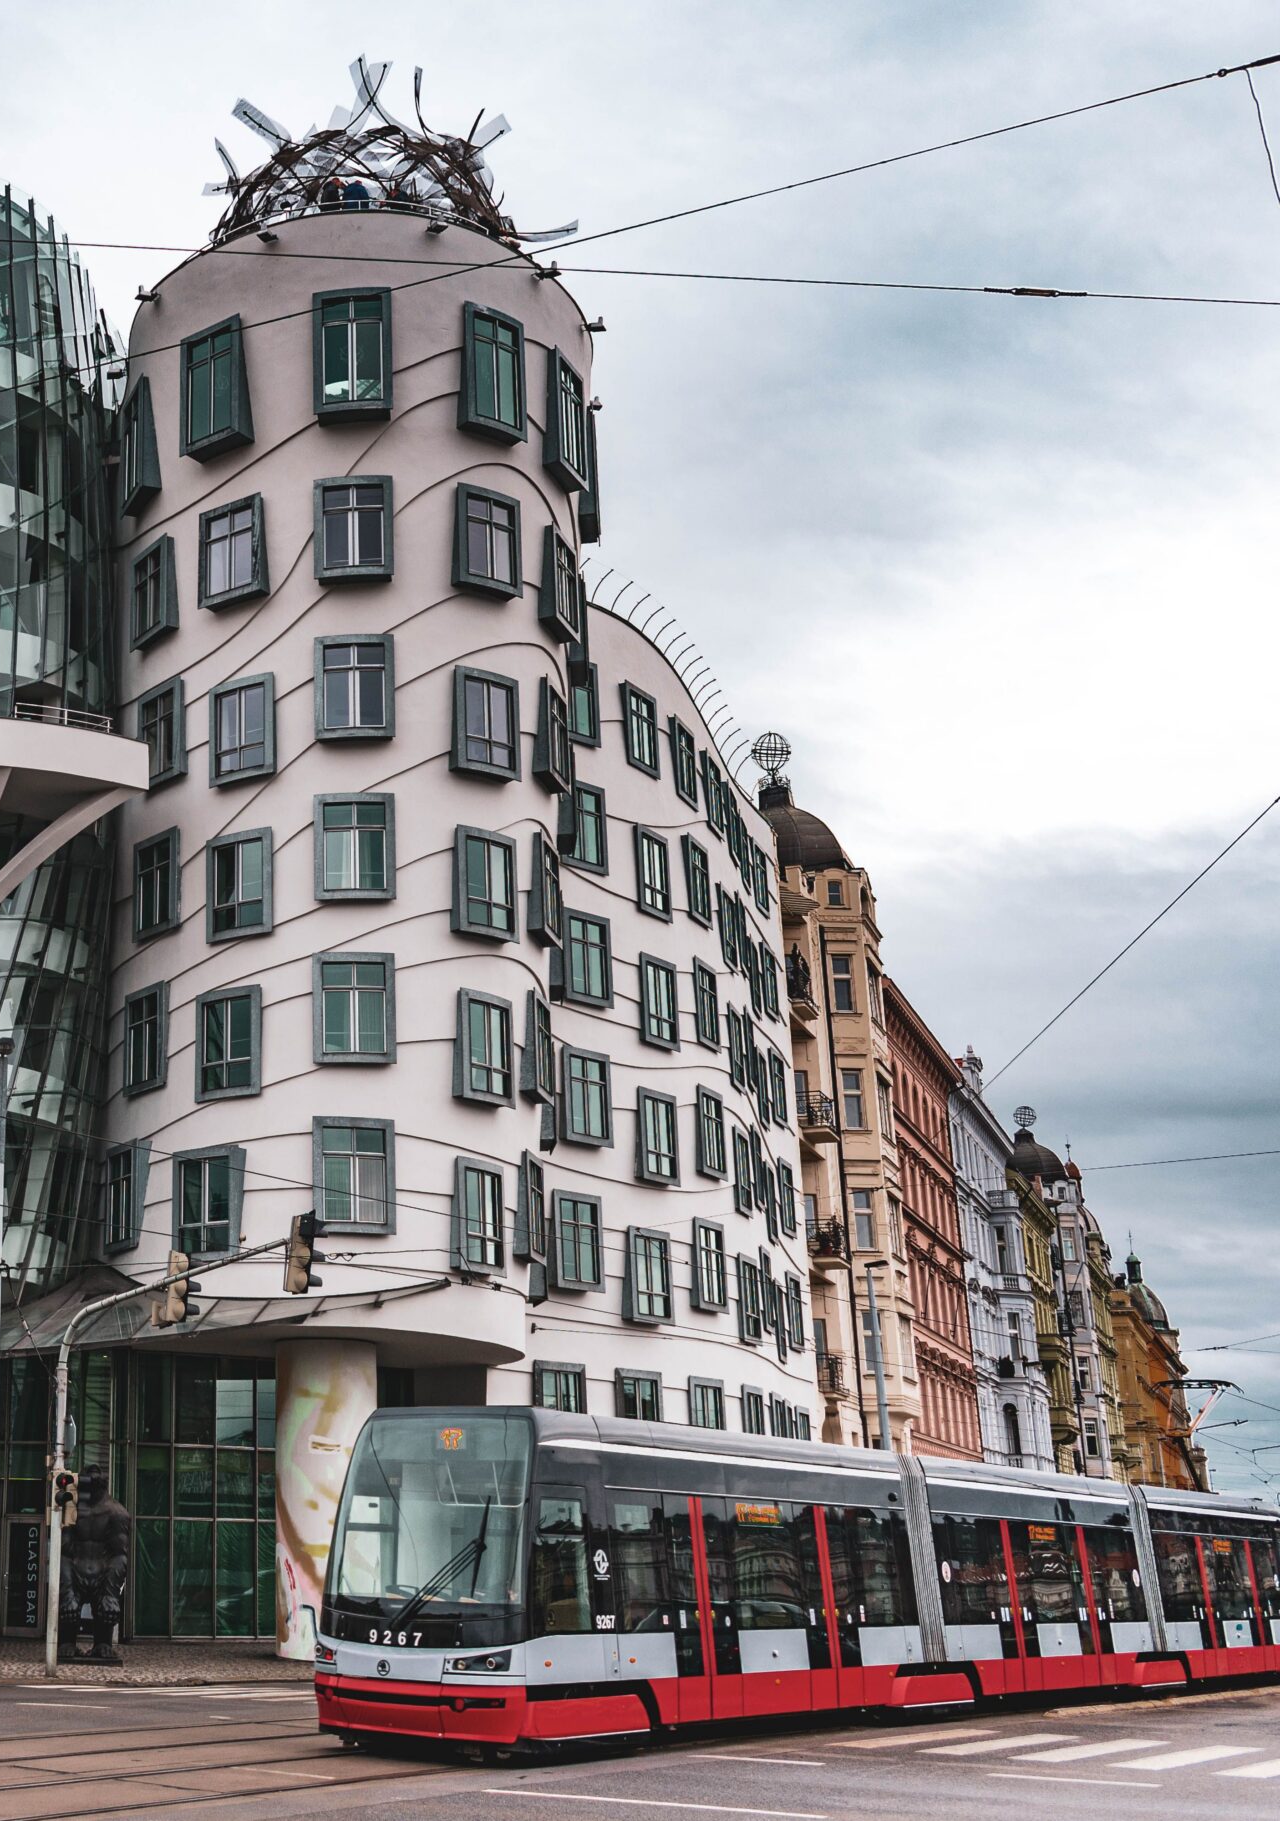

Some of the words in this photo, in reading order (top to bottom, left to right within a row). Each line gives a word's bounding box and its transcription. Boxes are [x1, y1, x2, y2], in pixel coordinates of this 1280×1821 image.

[440, 1427, 463, 1450] 17
[27, 1527, 39, 1582] GLASS
[26, 1590, 37, 1624] BAR
[596, 1614, 616, 1630] 9267
[369, 1628, 423, 1647] 9267
